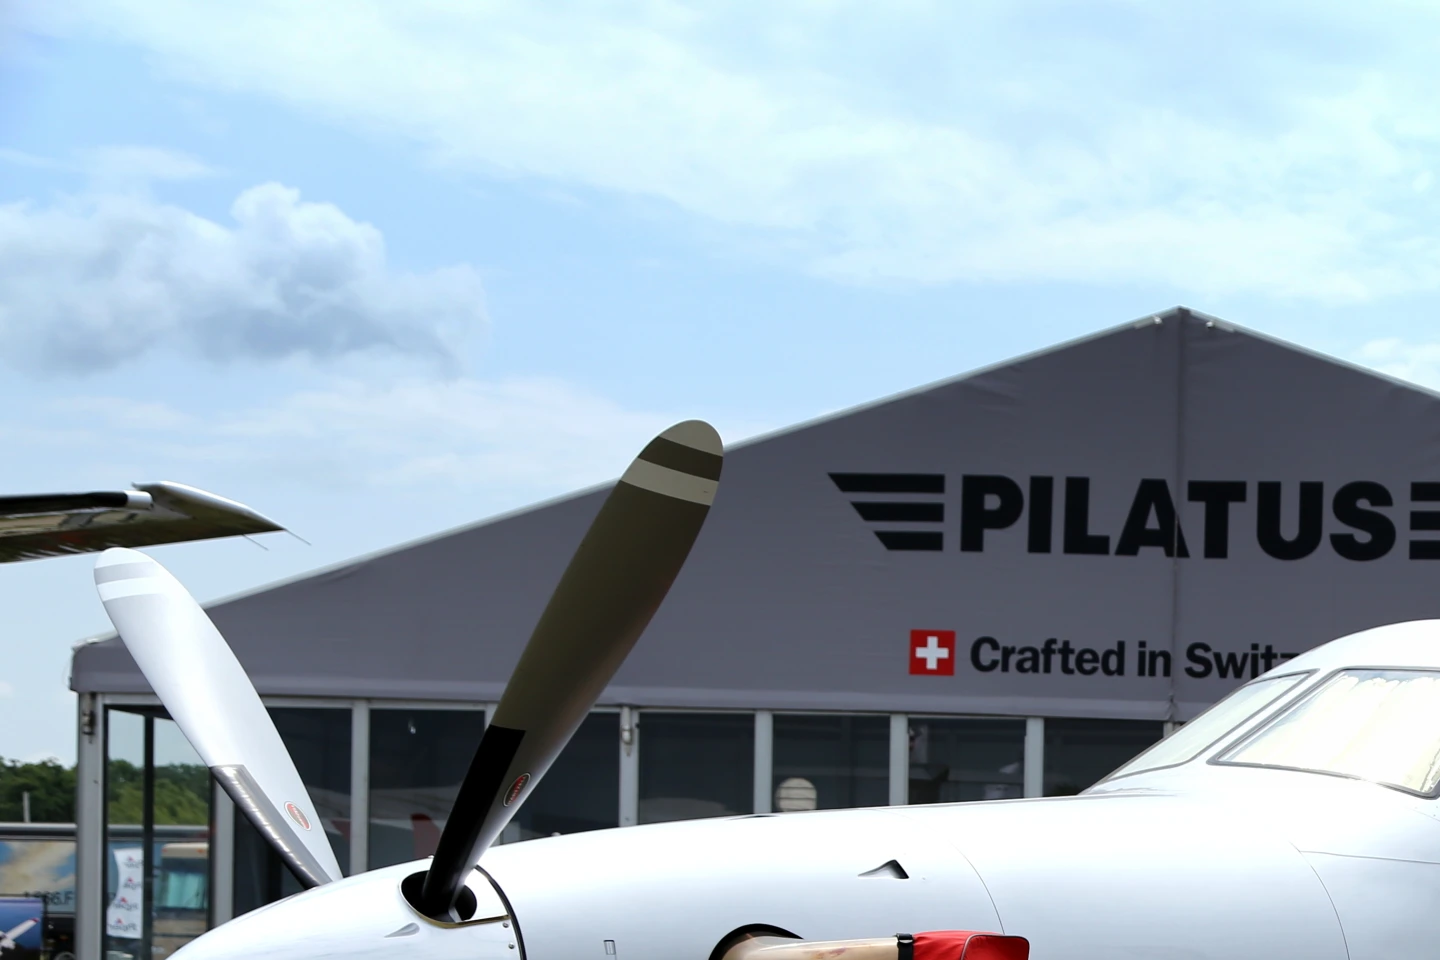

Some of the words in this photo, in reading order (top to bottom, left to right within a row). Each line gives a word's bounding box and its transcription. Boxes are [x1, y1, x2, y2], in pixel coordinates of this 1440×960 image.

[960, 474, 1396, 561] PILATUS
[969, 636, 1126, 677] Crafted
[1137, 640, 1172, 678] in
[1184, 643, 1300, 679] Swit
